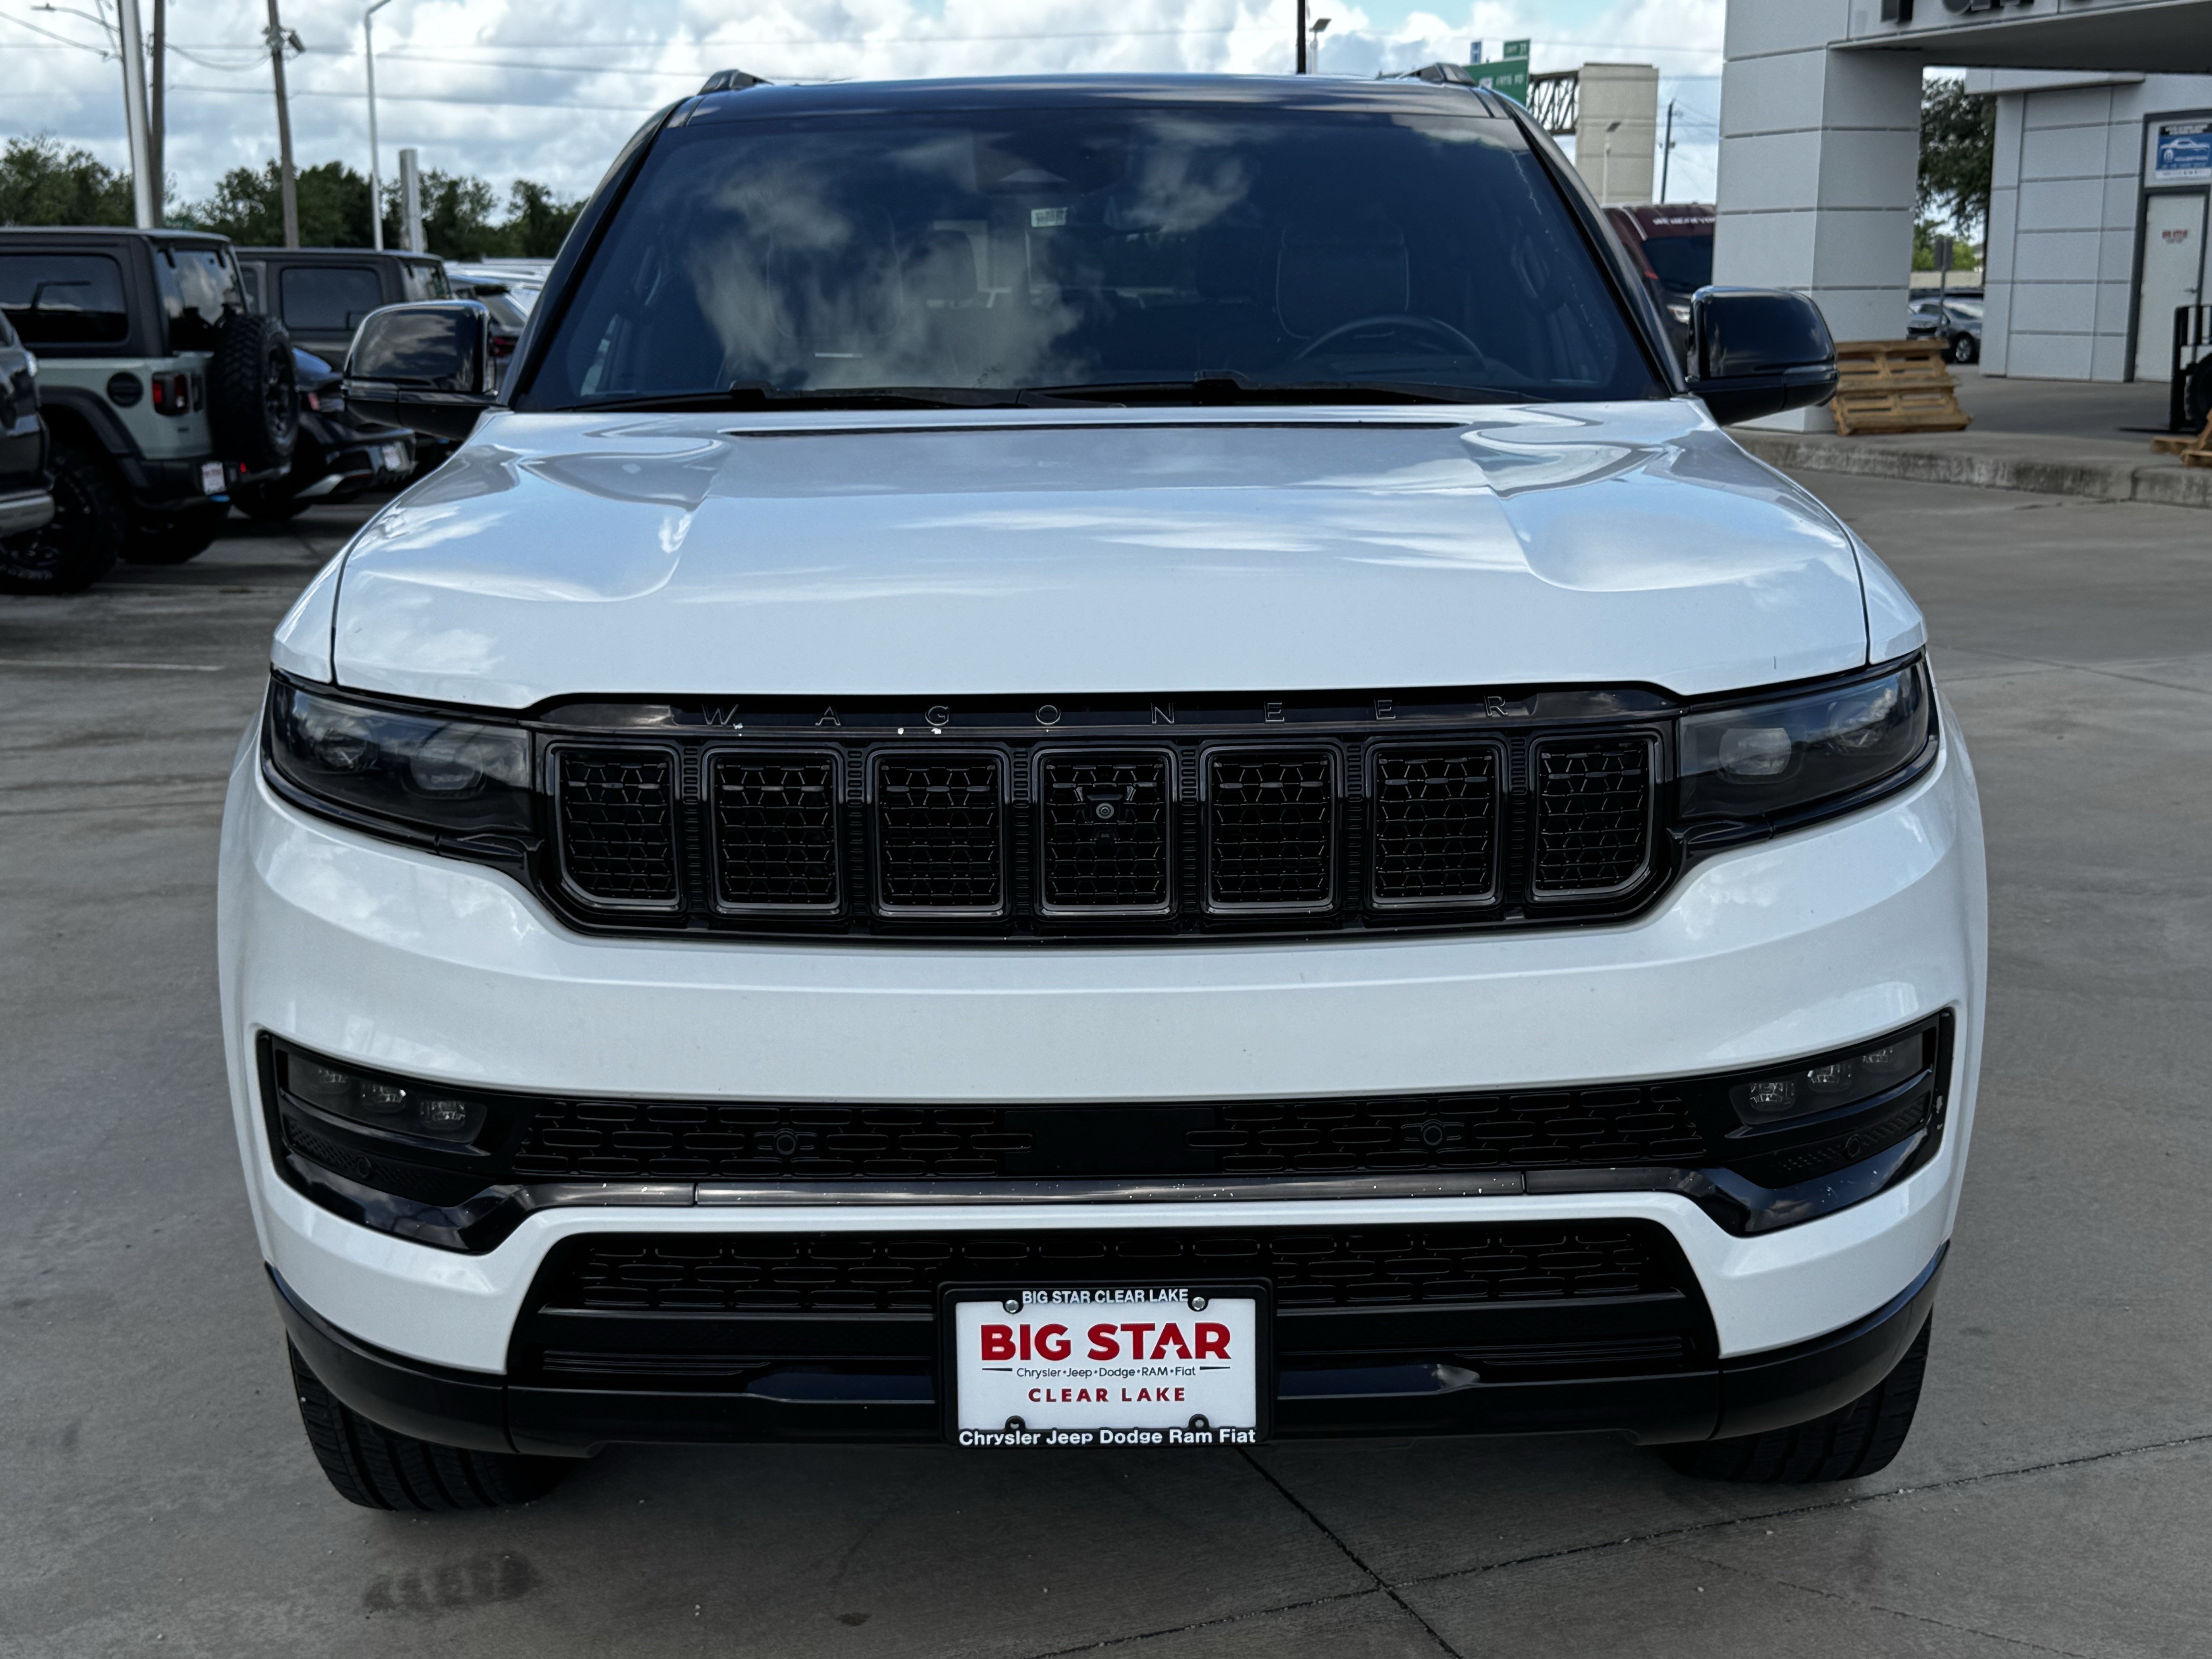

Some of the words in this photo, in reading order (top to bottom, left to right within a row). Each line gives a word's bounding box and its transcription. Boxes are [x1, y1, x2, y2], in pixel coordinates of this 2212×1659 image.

[701, 696, 1508, 726] WAGONEER
[1022, 1291, 1048, 1304] BIG
[1052, 1290, 1090, 1304] STAR
[1095, 1290, 1145, 1303] CLEAR
[1149, 1289, 1188, 1302] LAKE
[981, 1323, 1071, 1361] BIG
[1087, 1322, 1231, 1360] STAR
[1017, 1368, 1061, 1379] Chrysler
[1066, 1368, 1092, 1378] Jeep
[1099, 1367, 1135, 1378] Dodge
[1142, 1367, 1168, 1376] RAM
[1175, 1366, 1195, 1376] Fiat
[1028, 1388, 1109, 1402] CLEAR
[1122, 1387, 1185, 1402] LAKE
[959, 1430, 1041, 1445] Chrysler
[1046, 1430, 1093, 1445] Jeep
[1100, 1429, 1163, 1444] Dodge
[1170, 1429, 1212, 1444] Ram
[1219, 1428, 1256, 1443] Fiat
